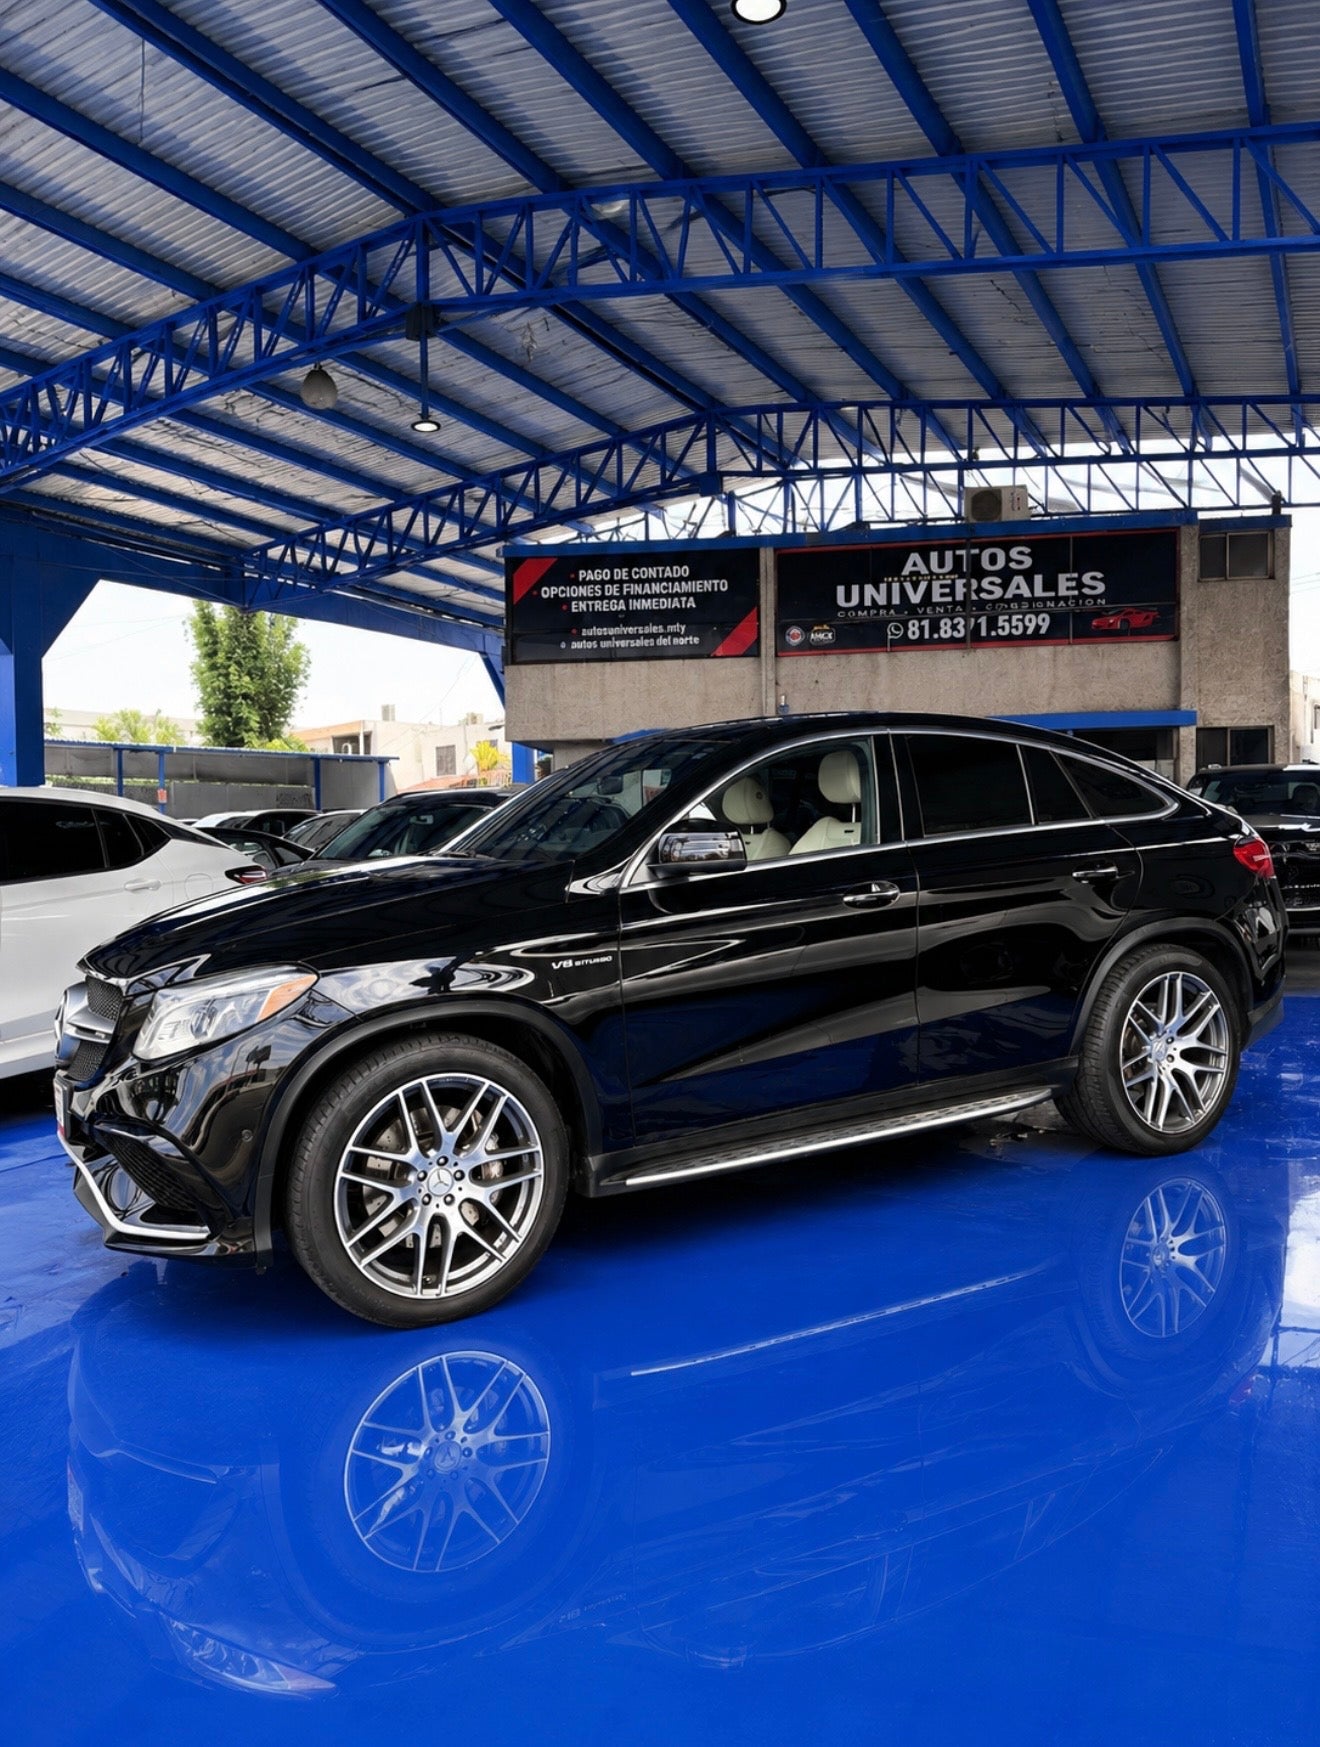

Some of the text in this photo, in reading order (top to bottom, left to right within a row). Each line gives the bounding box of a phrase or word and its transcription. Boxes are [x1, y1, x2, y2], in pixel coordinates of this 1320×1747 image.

[901, 545, 1033, 576] AUTOS
[579, 565, 690, 582] PAGO DE CONTADO
[541, 579, 729, 599] OPCIONES DE FINANCIAMIENTO
[836, 571, 1106, 608] UNIVERSALES
[571, 596, 697, 613] ENTREGA INMEDIATA
[837, 608, 896, 618] COMPRA
[916, 605, 963, 614] VENTA
[571, 635, 700, 649] autos universales del norte
